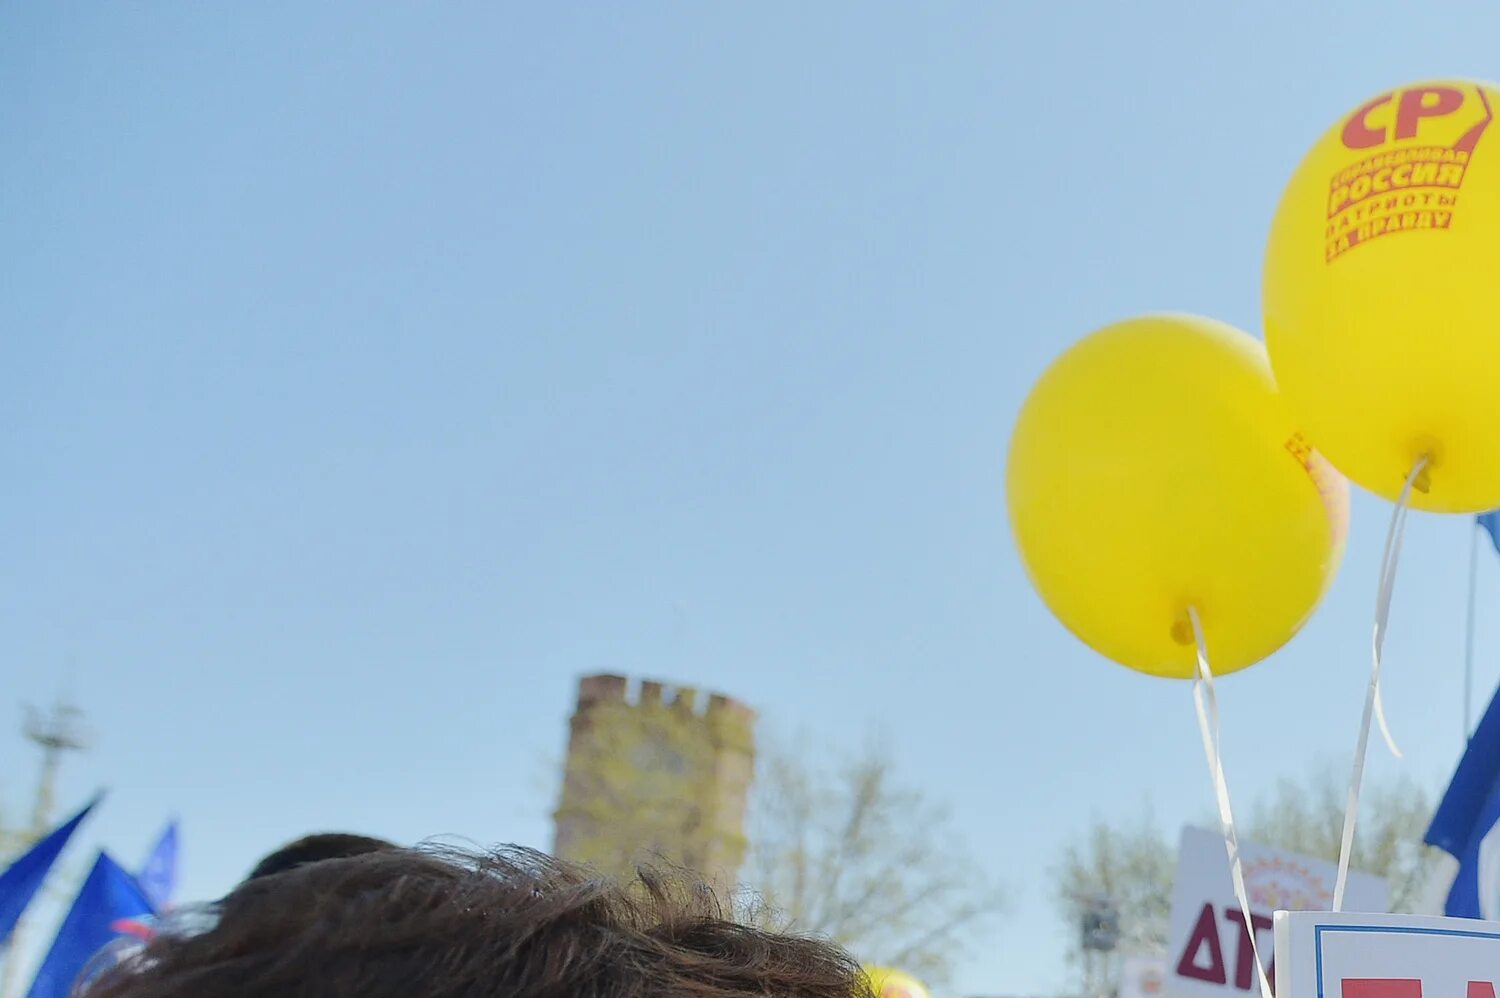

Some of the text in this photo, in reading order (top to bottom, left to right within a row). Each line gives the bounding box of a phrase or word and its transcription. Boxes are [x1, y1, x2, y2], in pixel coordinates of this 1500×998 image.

[1341, 86, 1465, 150] СР
[1326, 193, 1457, 240] ПАТРИОТЫ
[1327, 160, 1466, 218] РОССИЯ
[1325, 211, 1452, 263] ЗА ПРАВДУ
